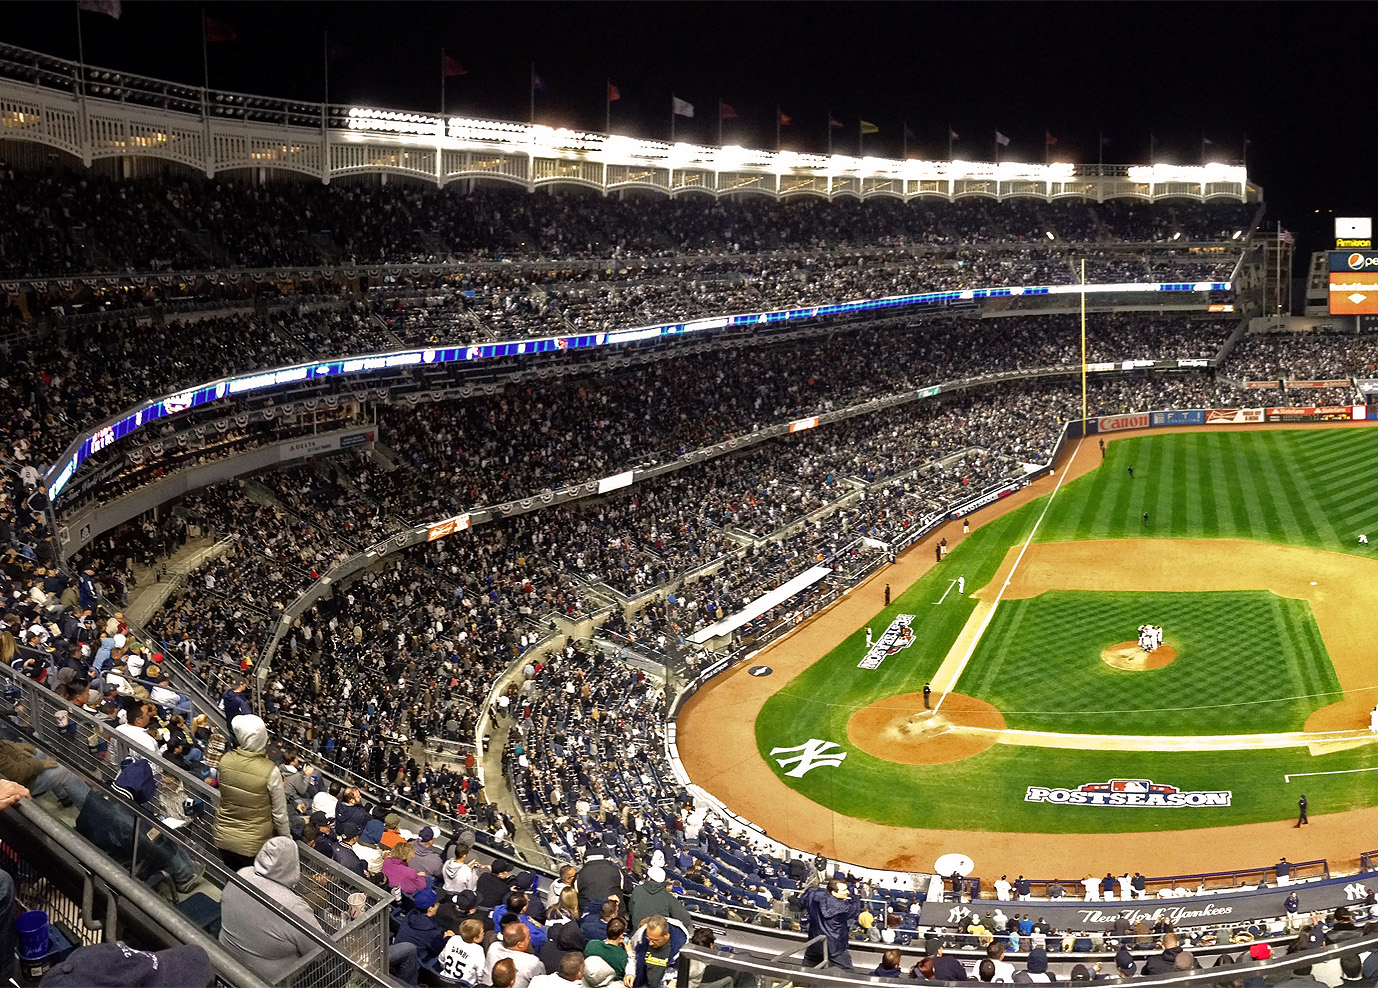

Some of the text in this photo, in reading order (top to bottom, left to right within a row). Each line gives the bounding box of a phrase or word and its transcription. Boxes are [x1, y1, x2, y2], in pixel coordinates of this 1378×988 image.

[1100, 416, 1149, 431] Canon
[296, 441, 316, 450] DELTA
[1028, 787, 1232, 806] POSTSEASON
[1344, 882, 1369, 900] NY
[1078, 903, 1233, 925] New York Yankees
[445, 955, 467, 979] 25
